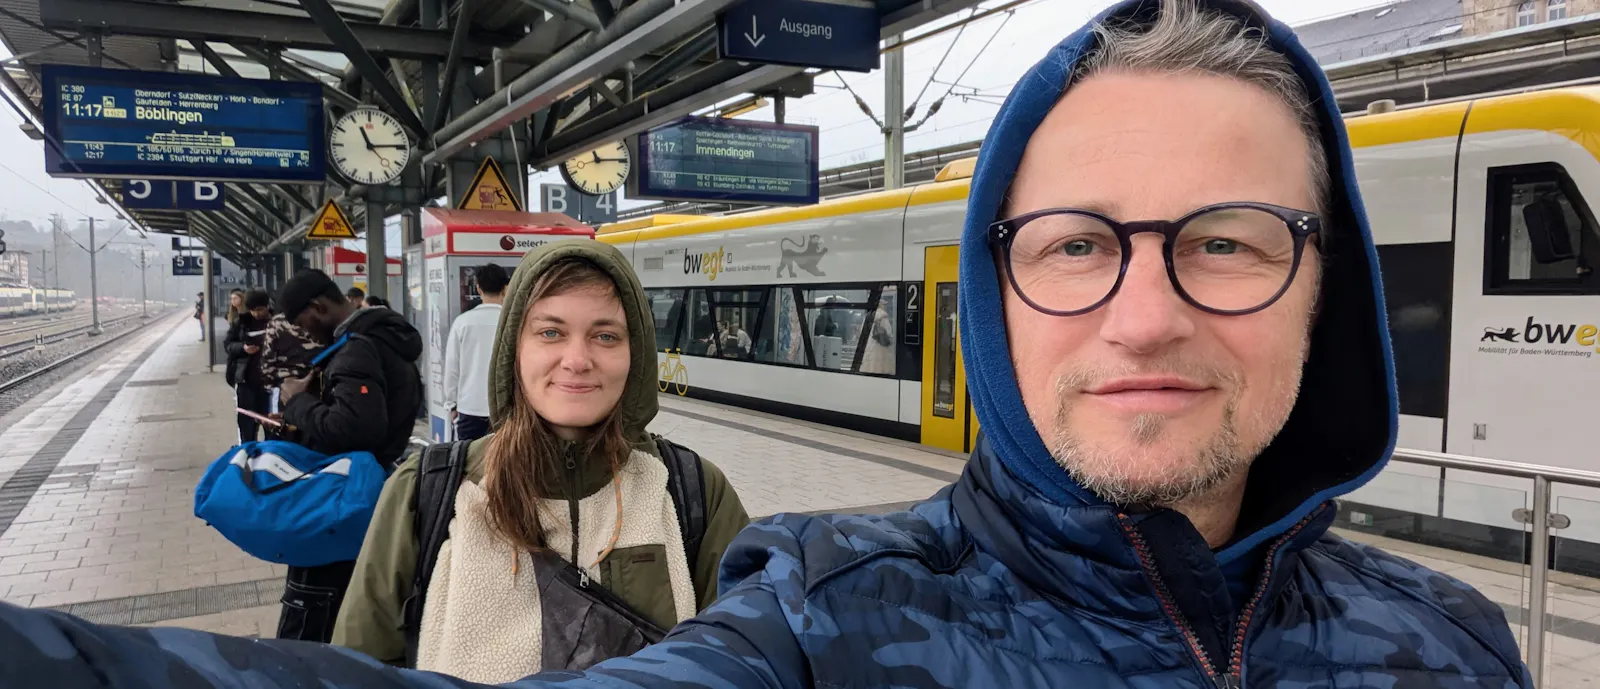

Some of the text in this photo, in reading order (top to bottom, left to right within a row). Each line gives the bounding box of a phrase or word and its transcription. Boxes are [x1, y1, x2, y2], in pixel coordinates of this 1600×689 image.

[779, 18, 832, 40] Ausgang
[71, 85, 85, 94] 380
[135, 89, 170, 98] Oberndorf
[178, 92, 223, 102] Sulz(Neckar)
[253, 96, 280, 106] Bondorf
[62, 102, 102, 116] 11:17
[136, 98, 172, 107] Gäufelden
[179, 100, 218, 110] Herrenberg
[136, 106, 202, 124] Böblingen
[650, 140, 676, 152] 11:17
[696, 144, 754, 160] Immendingen
[170, 154, 204, 162] Stuttgart
[547, 185, 613, 215] B 4
[516, 240, 548, 248] select
[683, 245, 725, 282] bwegt
[907, 284, 918, 310] 2
[1523, 316, 1600, 354] bwe
[1508, 348, 1518, 356] für
[1520, 348, 1592, 358] Baden-Württemberg
